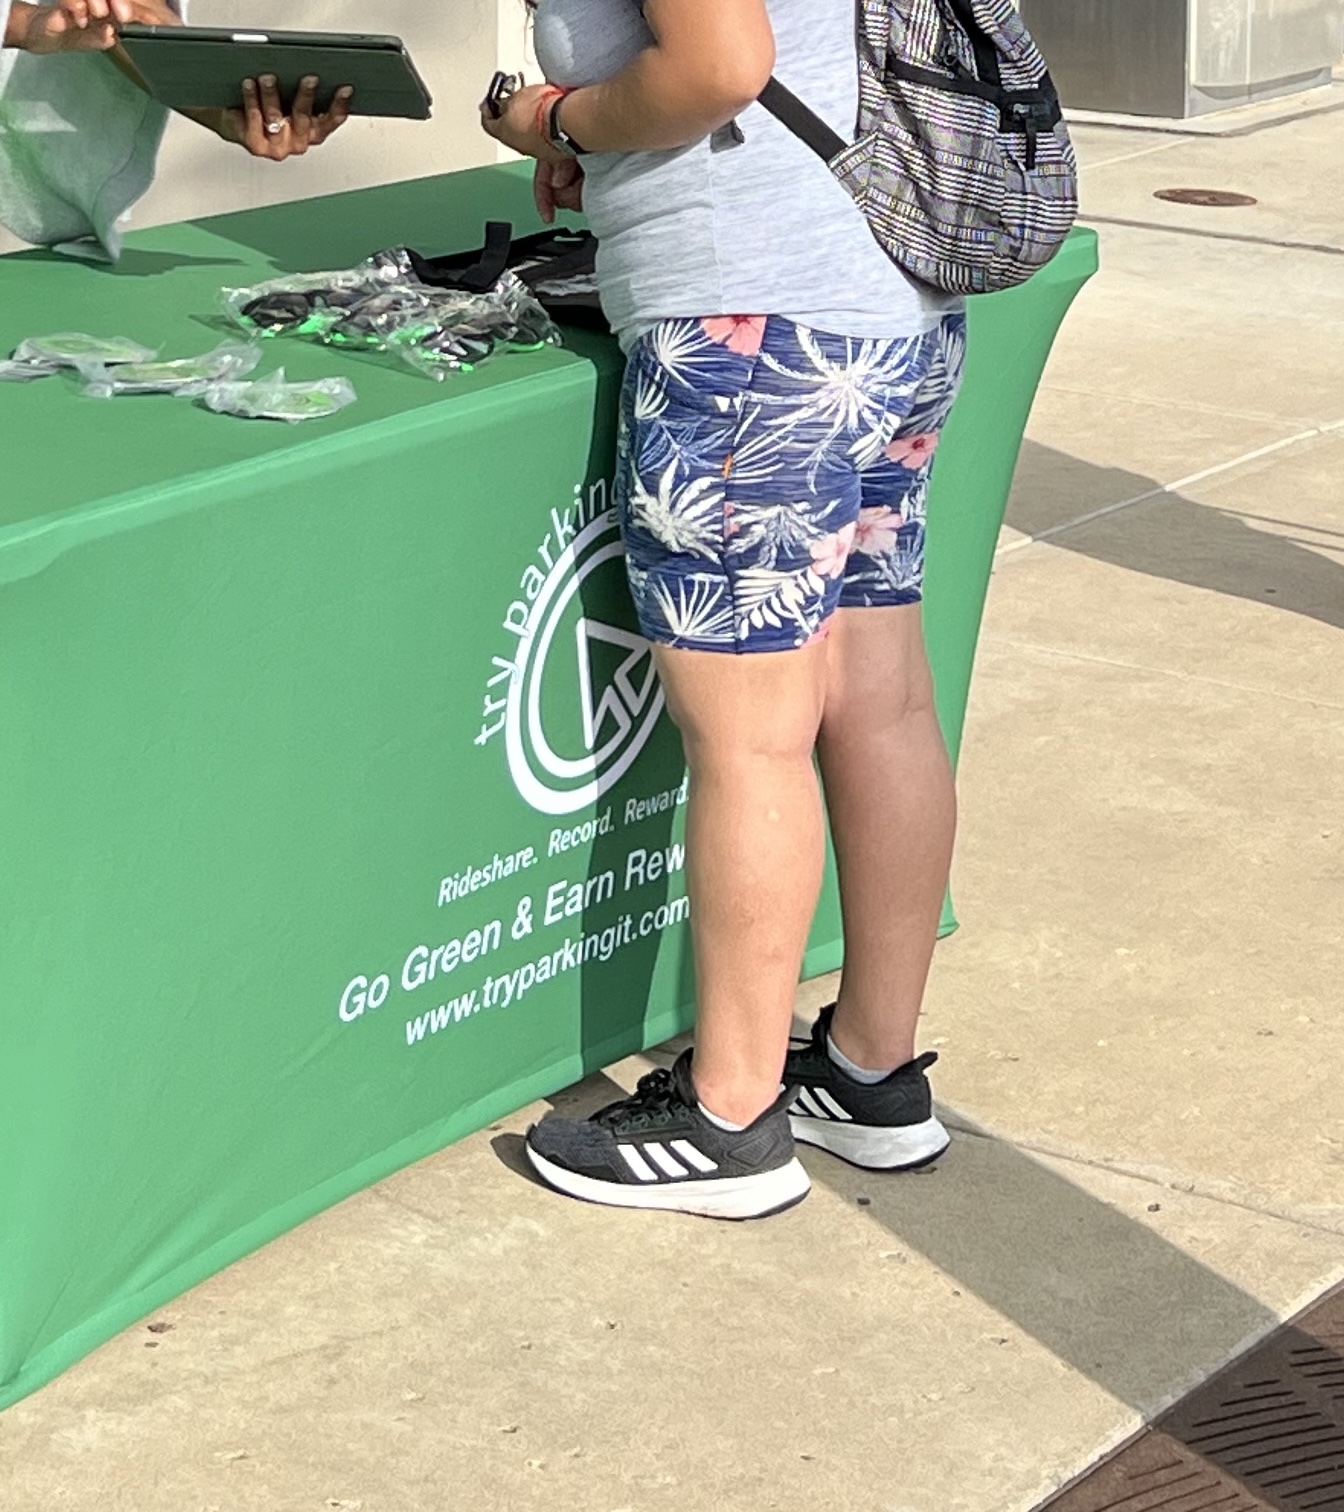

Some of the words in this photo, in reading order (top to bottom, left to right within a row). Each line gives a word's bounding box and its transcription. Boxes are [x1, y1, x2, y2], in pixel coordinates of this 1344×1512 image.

[474, 656, 519, 746] try
[437, 842, 538, 907] Rideshare.
[547, 805, 614, 857] Record.
[623, 776, 690, 825] Reward.
[338, 970, 390, 1024] Go
[401, 916, 501, 993] Green
[510, 895, 534, 940] &
[543, 869, 614, 926] Earn
[623, 843, 685, 891] Rew
[405, 895, 690, 1045] www.tryparkingit.com
